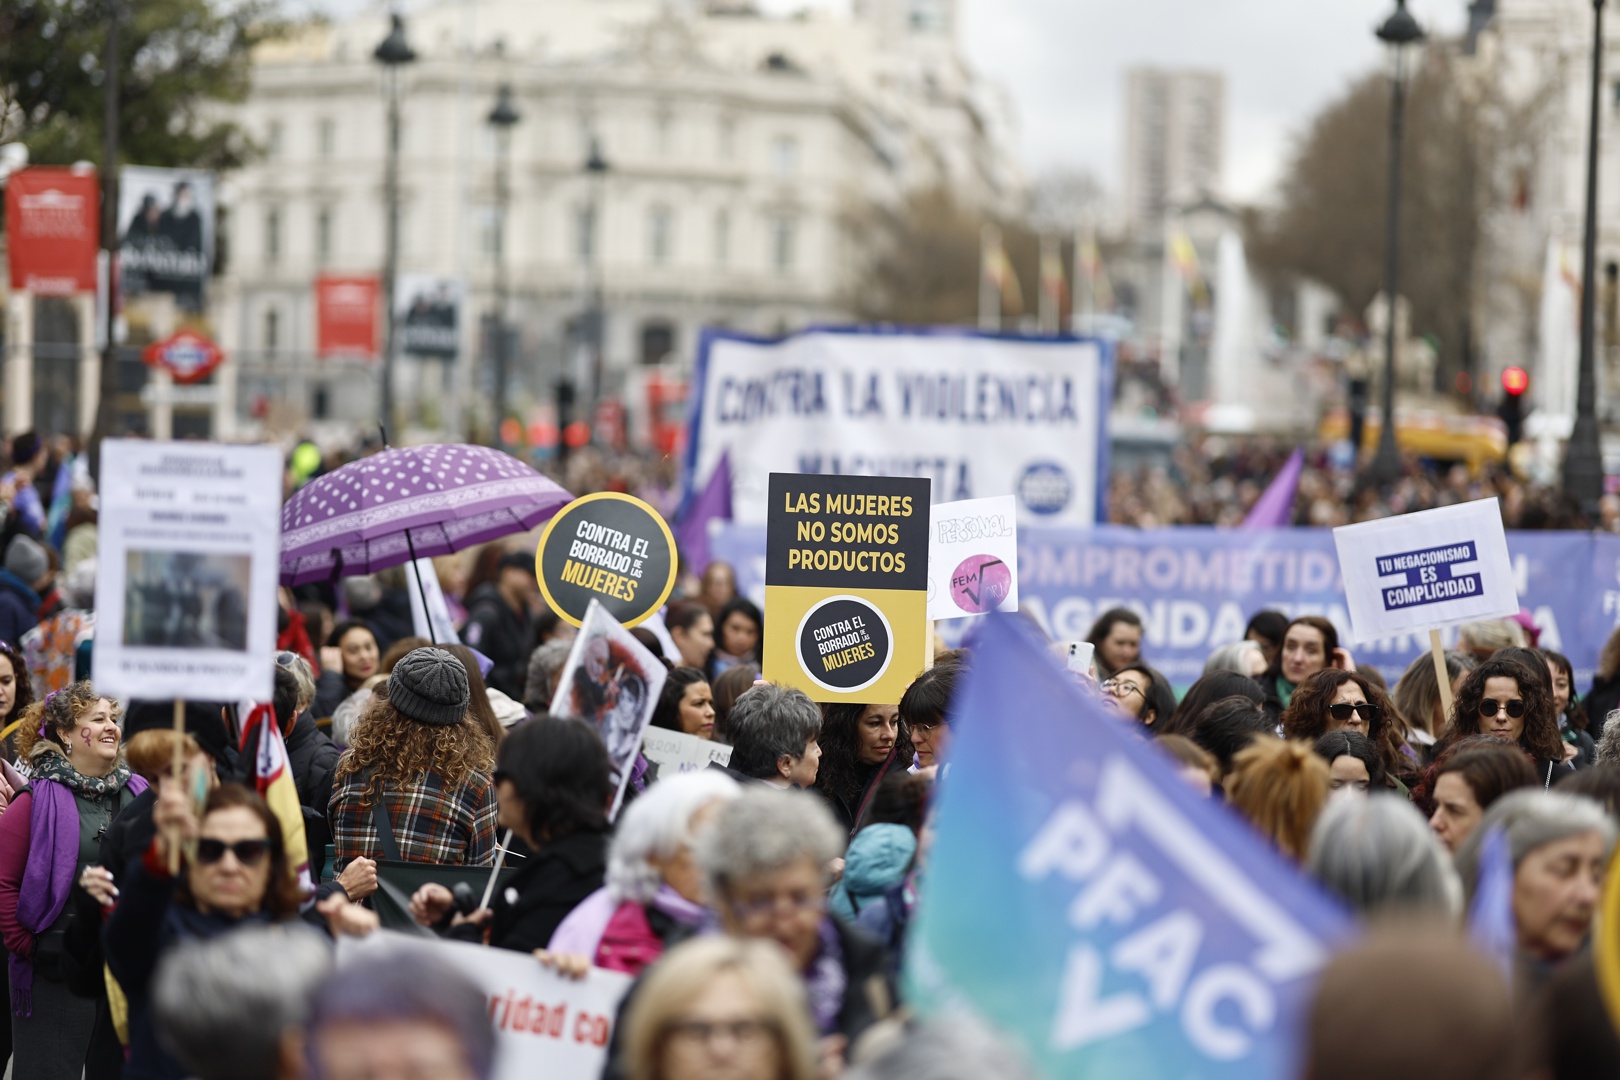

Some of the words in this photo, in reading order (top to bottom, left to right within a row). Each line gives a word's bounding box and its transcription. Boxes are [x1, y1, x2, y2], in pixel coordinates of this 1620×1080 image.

[716, 369, 827, 425] CONTRA
[842, 369, 886, 419] LA
[895, 370, 1078, 425] VIOLENCIA
[785, 492, 821, 514] LAS
[826, 493, 913, 517] MUJERES
[576, 520, 632, 552] CONTRA
[632, 537, 649, 559] EL
[797, 521, 826, 543] NO
[830, 521, 899, 545] SOMOS
[937, 514, 1013, 544] PERSONAL
[569, 539, 632, 573] BORRADO
[633, 559, 643, 569] DE
[788, 549, 906, 573] PRODUCTOS
[1379, 558, 1393, 573] TU
[1394, 545, 1471, 571] NEGACIONISMO
[560, 559, 638, 602] MUJERES
[630, 568, 643, 578] LAS
[953, 573, 978, 588] FEM
[1420, 566, 1438, 584] ES
[1387, 577, 1476, 606] COMPLICIDAD
[813, 619, 852, 642] CONTRA
[852, 616, 866, 629] EL
[818, 631, 860, 655] BORRADO
[860, 628, 866, 636] DE
[822, 642, 875, 672] MUJERES
